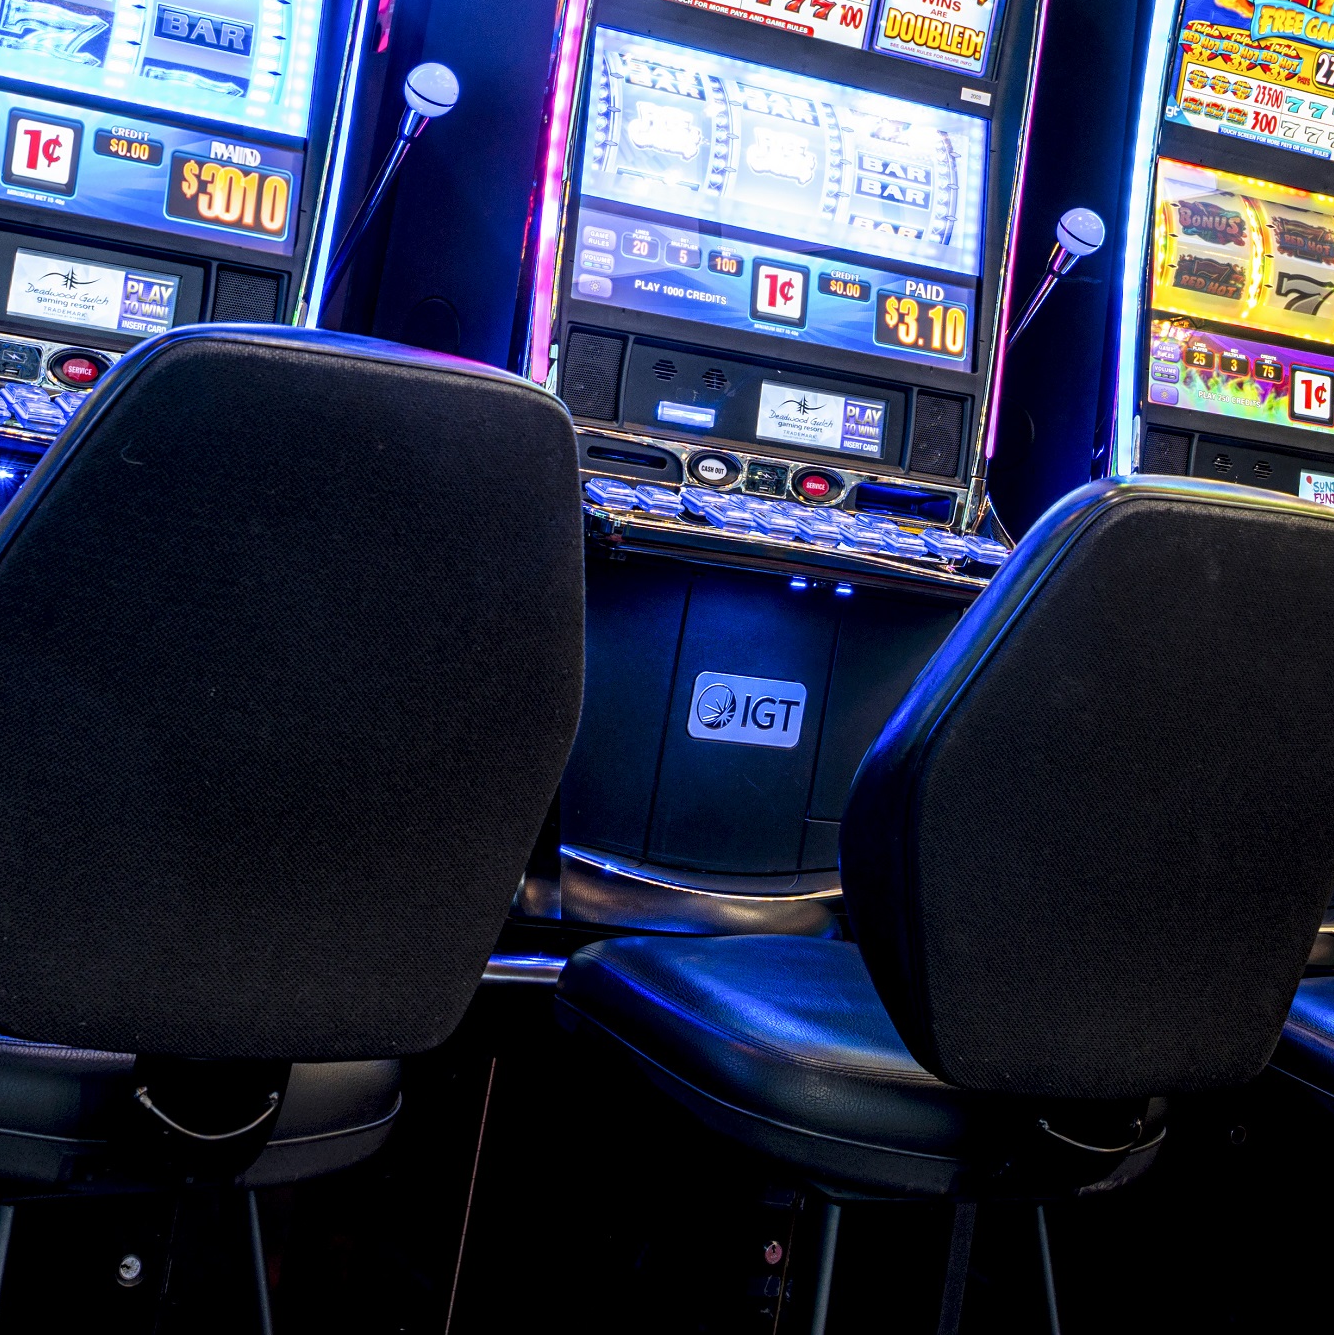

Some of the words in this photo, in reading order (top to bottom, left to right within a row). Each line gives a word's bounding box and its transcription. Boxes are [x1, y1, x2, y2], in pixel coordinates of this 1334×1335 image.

[930, 9, 947, 18] ARE
[884, 7, 985, 61] DOUBLED!
[635, 280, 660, 292] PLAY
[663, 285, 684, 297] 1000
[687, 290, 727, 304] CREDITS
[905, 279, 945, 302] PAID
[885, 297, 965, 353] $3.10
[68, 365, 92, 376] SERVICE
[740, 694, 801, 732] IGT
